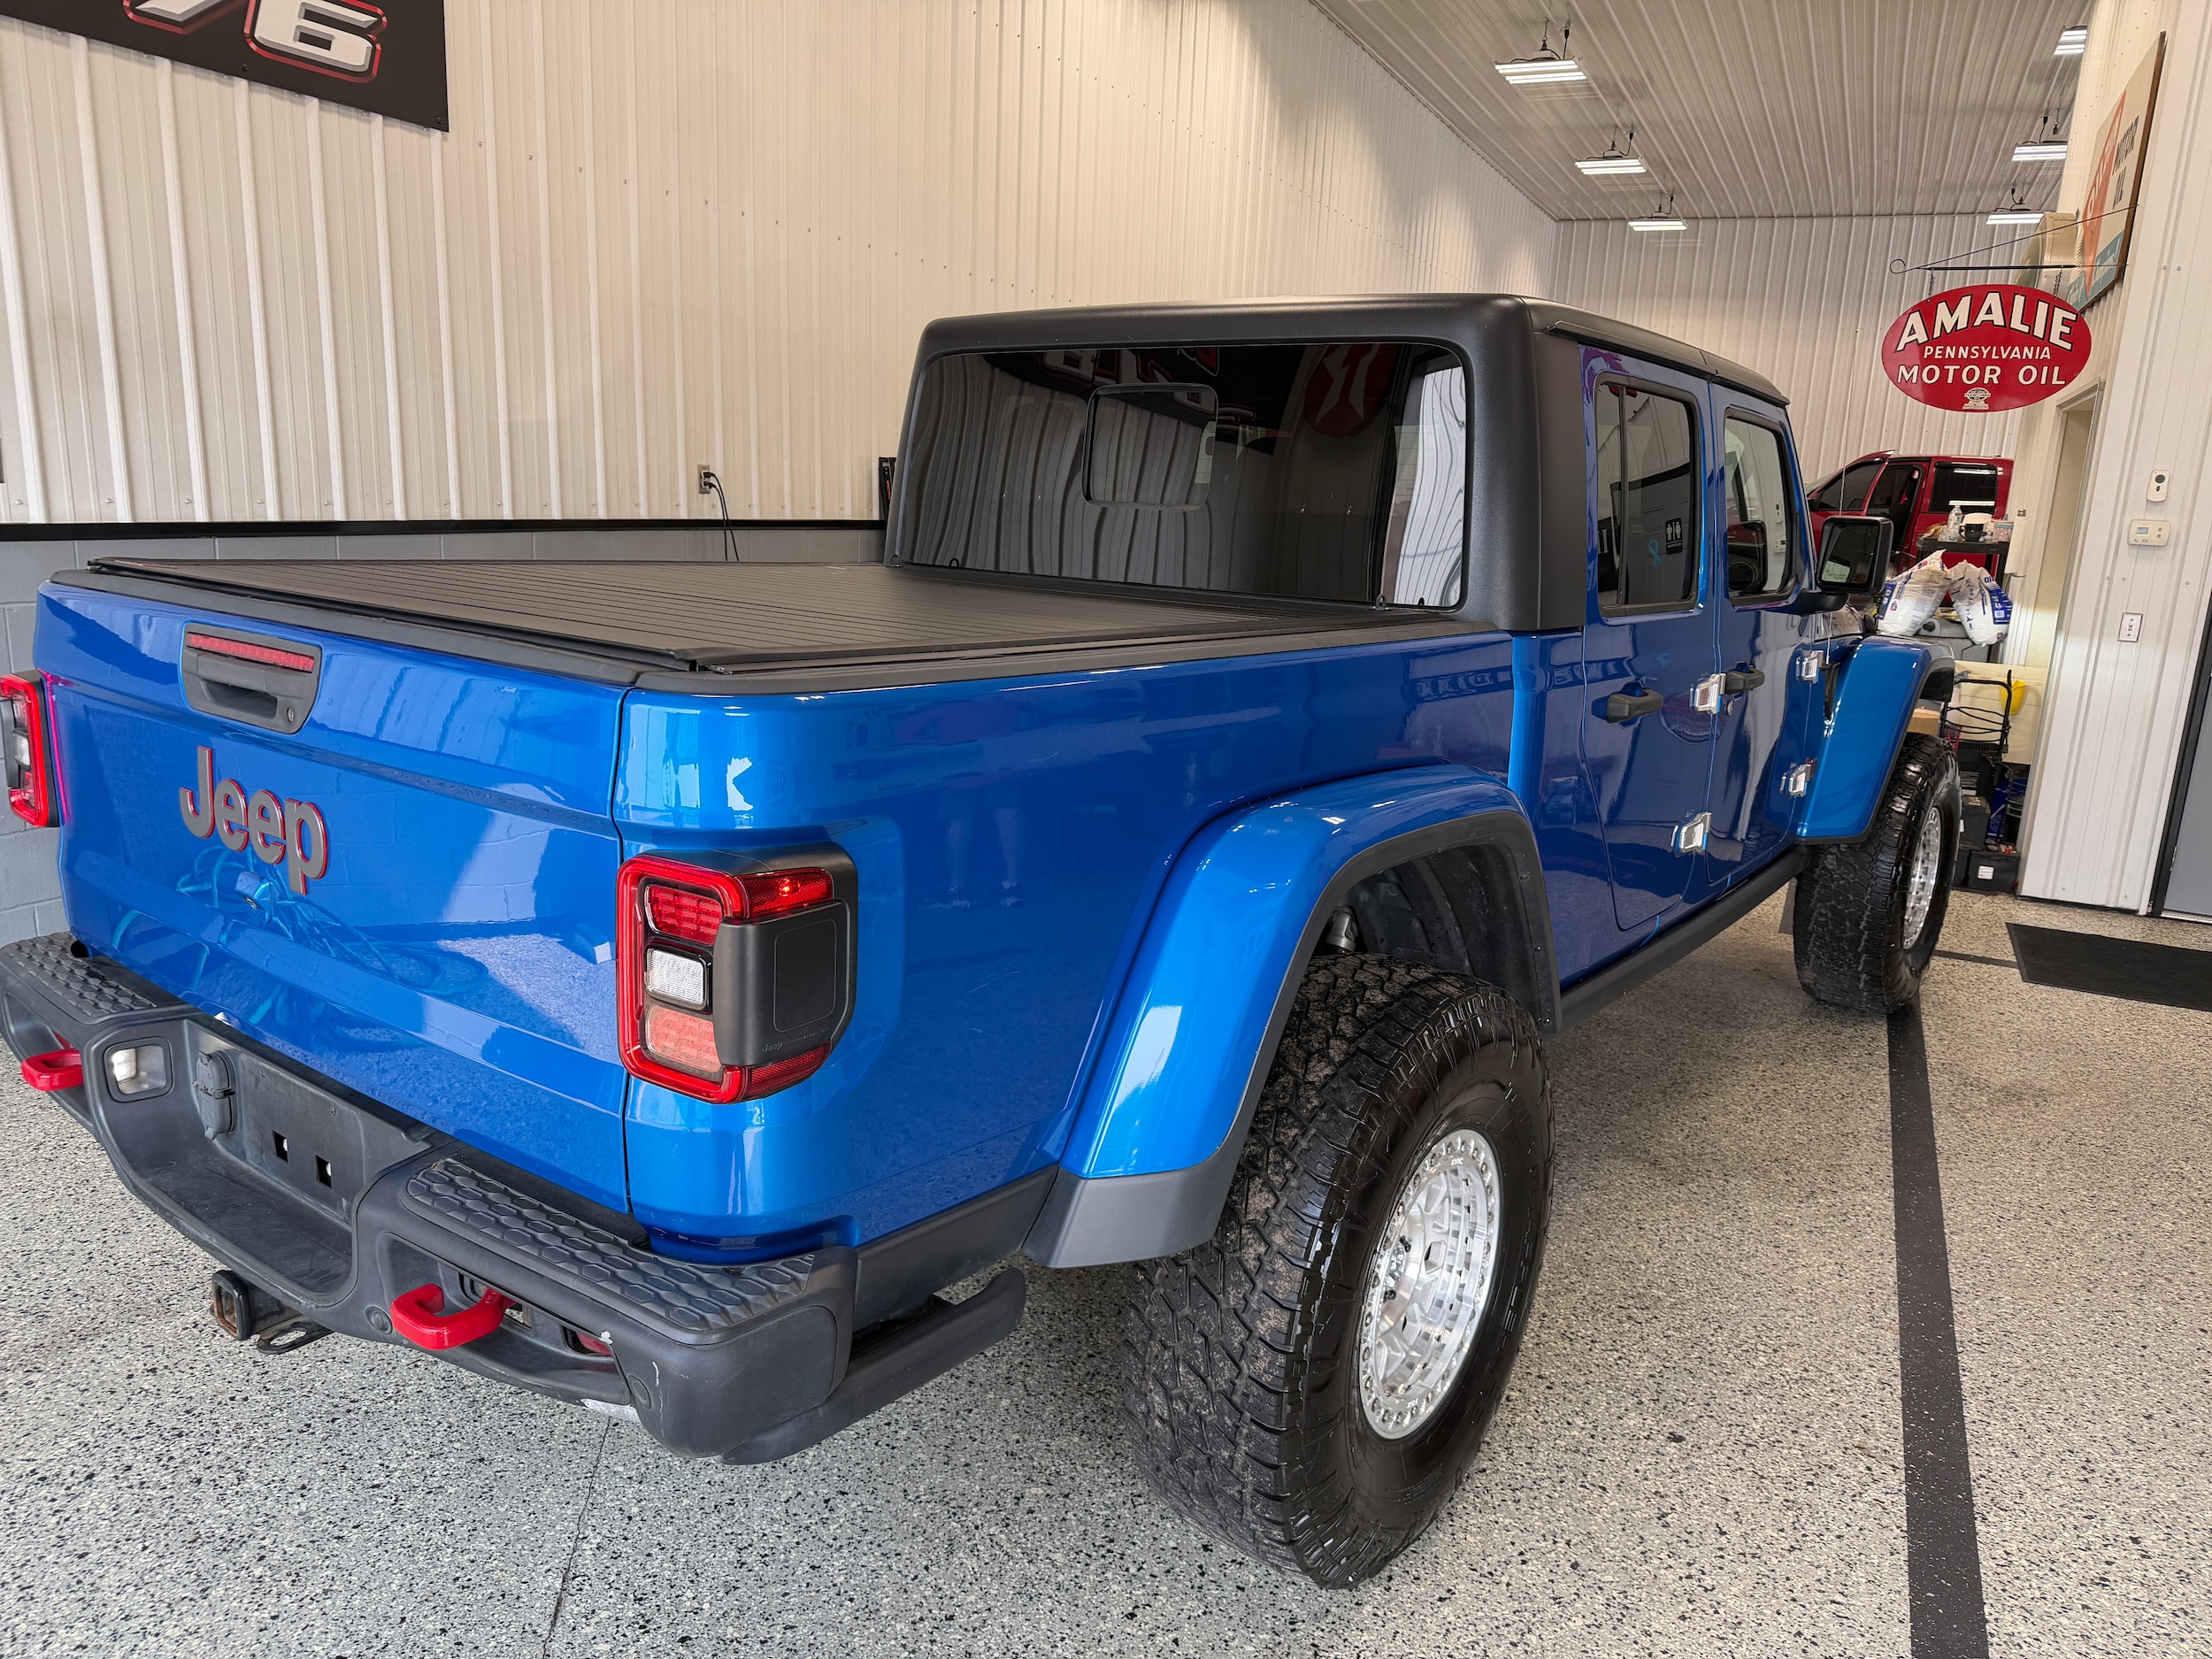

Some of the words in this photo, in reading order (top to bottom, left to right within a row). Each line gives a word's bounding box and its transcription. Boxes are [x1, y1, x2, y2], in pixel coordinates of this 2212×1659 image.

[1894, 291, 2078, 352] AMALIE
[1924, 346, 2051, 359] PENNSYLVANIA
[1897, 365, 2001, 385] MOTOR
[2017, 365, 2066, 385] OIL
[180, 745, 328, 895] Jeep
